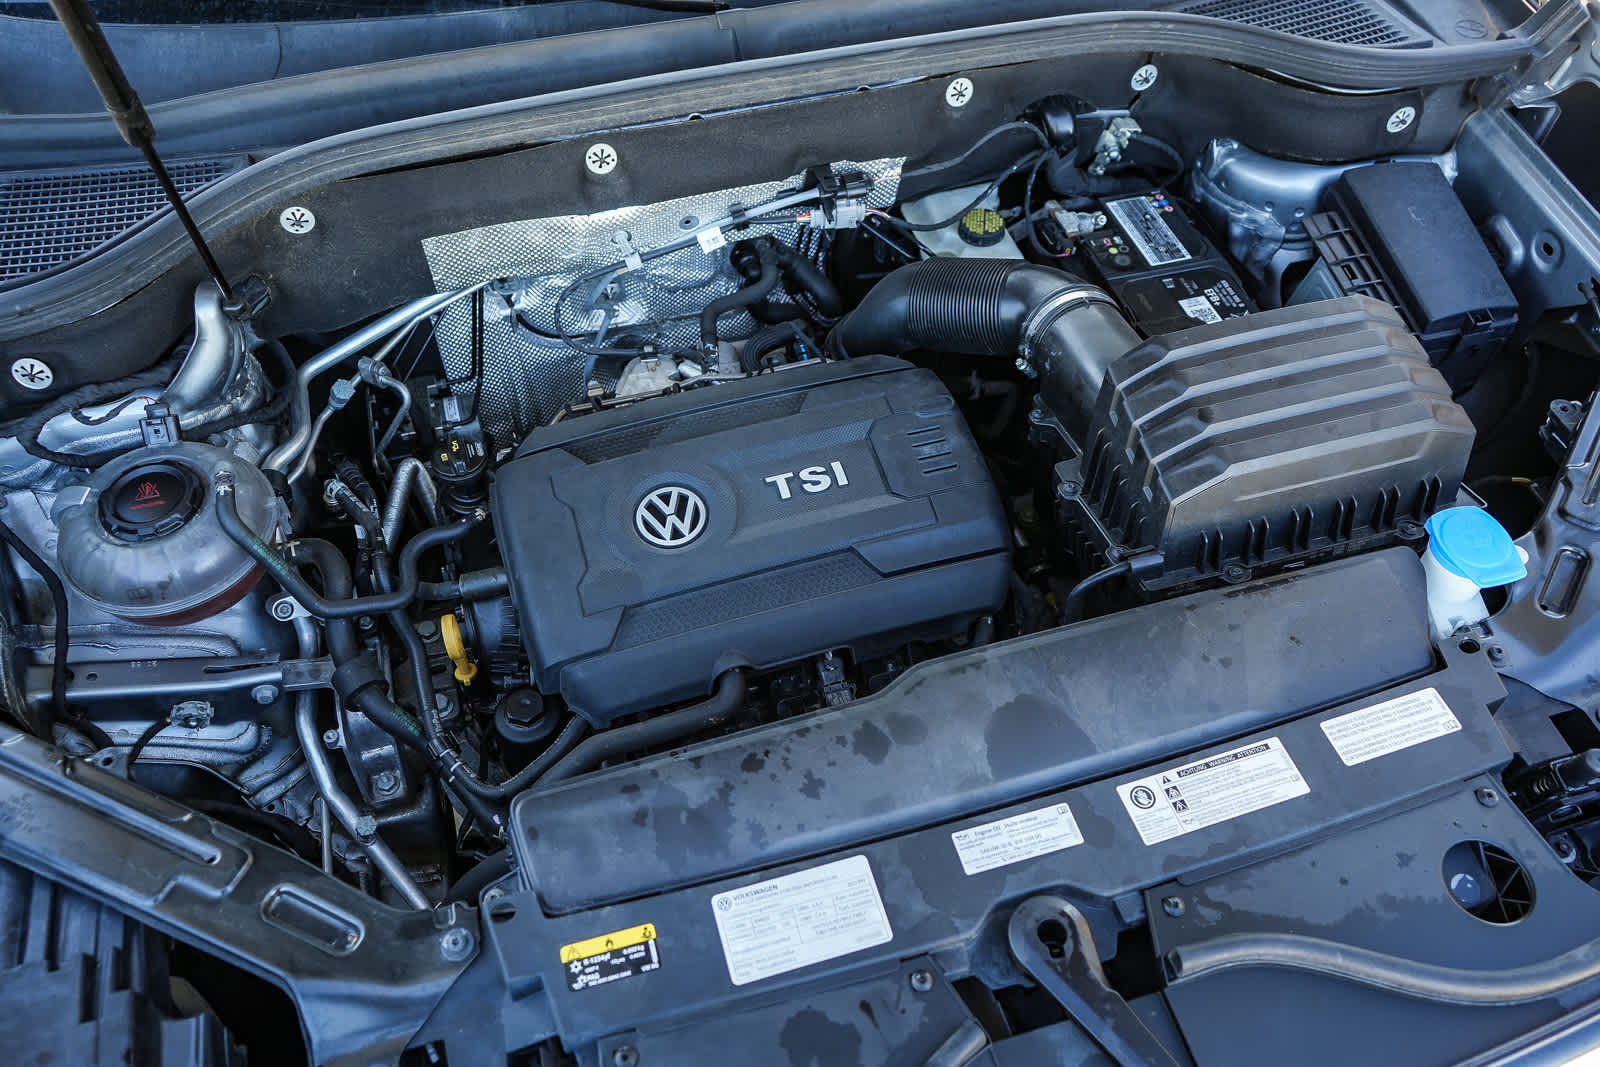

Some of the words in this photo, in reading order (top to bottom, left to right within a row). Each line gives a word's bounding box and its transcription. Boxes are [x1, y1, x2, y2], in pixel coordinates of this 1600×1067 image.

[765, 461, 849, 499] TSI
[636, 486, 707, 546] VW
[1180, 762, 1207, 777] ACHTUNG
[1209, 755, 1236, 767] WARNING
[1237, 744, 1267, 759] ATTENTION
[734, 883, 778, 901] VOLKSWAGEN
